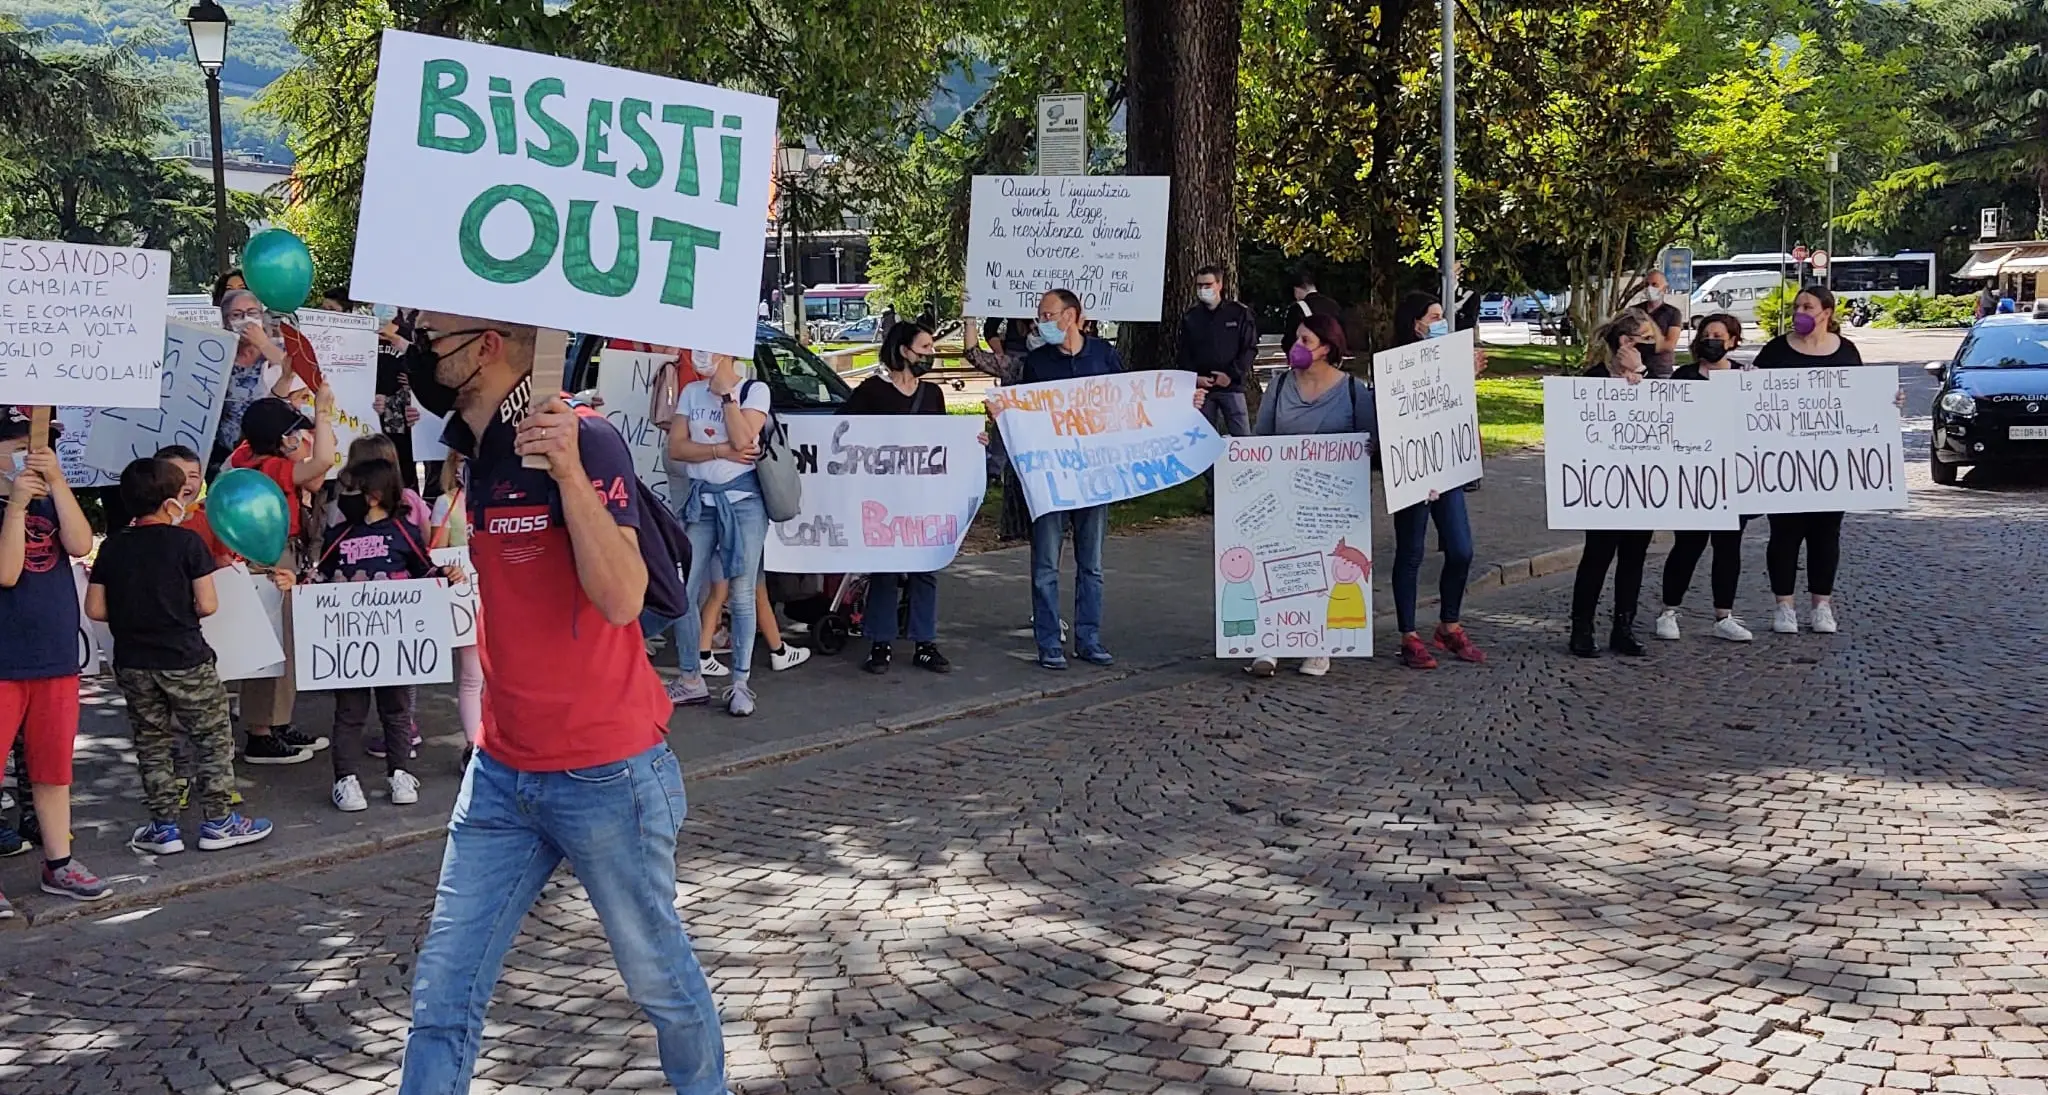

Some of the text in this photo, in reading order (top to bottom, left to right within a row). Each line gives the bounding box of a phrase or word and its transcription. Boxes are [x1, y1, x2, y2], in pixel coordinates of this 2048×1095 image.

[1011, 198, 1060, 218] diventa
[989, 217, 1142, 240] la resistenza diventa
[459, 183, 721, 310] OUT
[985, 260, 1002, 278] NO
[1005, 269, 1024, 278] ALLA
[1079, 264, 1104, 280] 290
[1111, 270, 1128, 280] PER
[7, 278, 109, 297] CAMBIATE
[1009, 280, 1037, 290] BENE
[1062, 278, 1093, 290] TUTTI
[43, 304, 133, 320] COMPAGNI
[988, 299, 1003, 307] DEL
[4, 321, 137, 337] TERZA VOLTA
[25, 362, 39, 379] A
[1740, 369, 1851, 391] Le classi PRIME
[1573, 379, 1588, 401] Le
[1650, 380, 1694, 403] PRIME
[1754, 391, 1842, 412] della scuola
[1580, 403, 1675, 424] della scuola
[1746, 410, 1845, 432] DON MILANI
[1611, 422, 1675, 445] RODARI
[1872, 423, 1880, 434] 1
[1451, 413, 1478, 468] NO!
[1704, 439, 1713, 452] 2
[1228, 440, 1273, 463] SONO
[1280, 445, 1298, 462] UN
[1847, 442, 1893, 492] NO!
[1679, 457, 1728, 511] NO!
[488, 514, 550, 534] CROSS
[861, 499, 958, 548] BANCHI
[316, 583, 422, 608] mi chiamo
[324, 608, 425, 639] MIRYAM e
[1277, 610, 1311, 626] NON
[397, 638, 438, 677] NO
